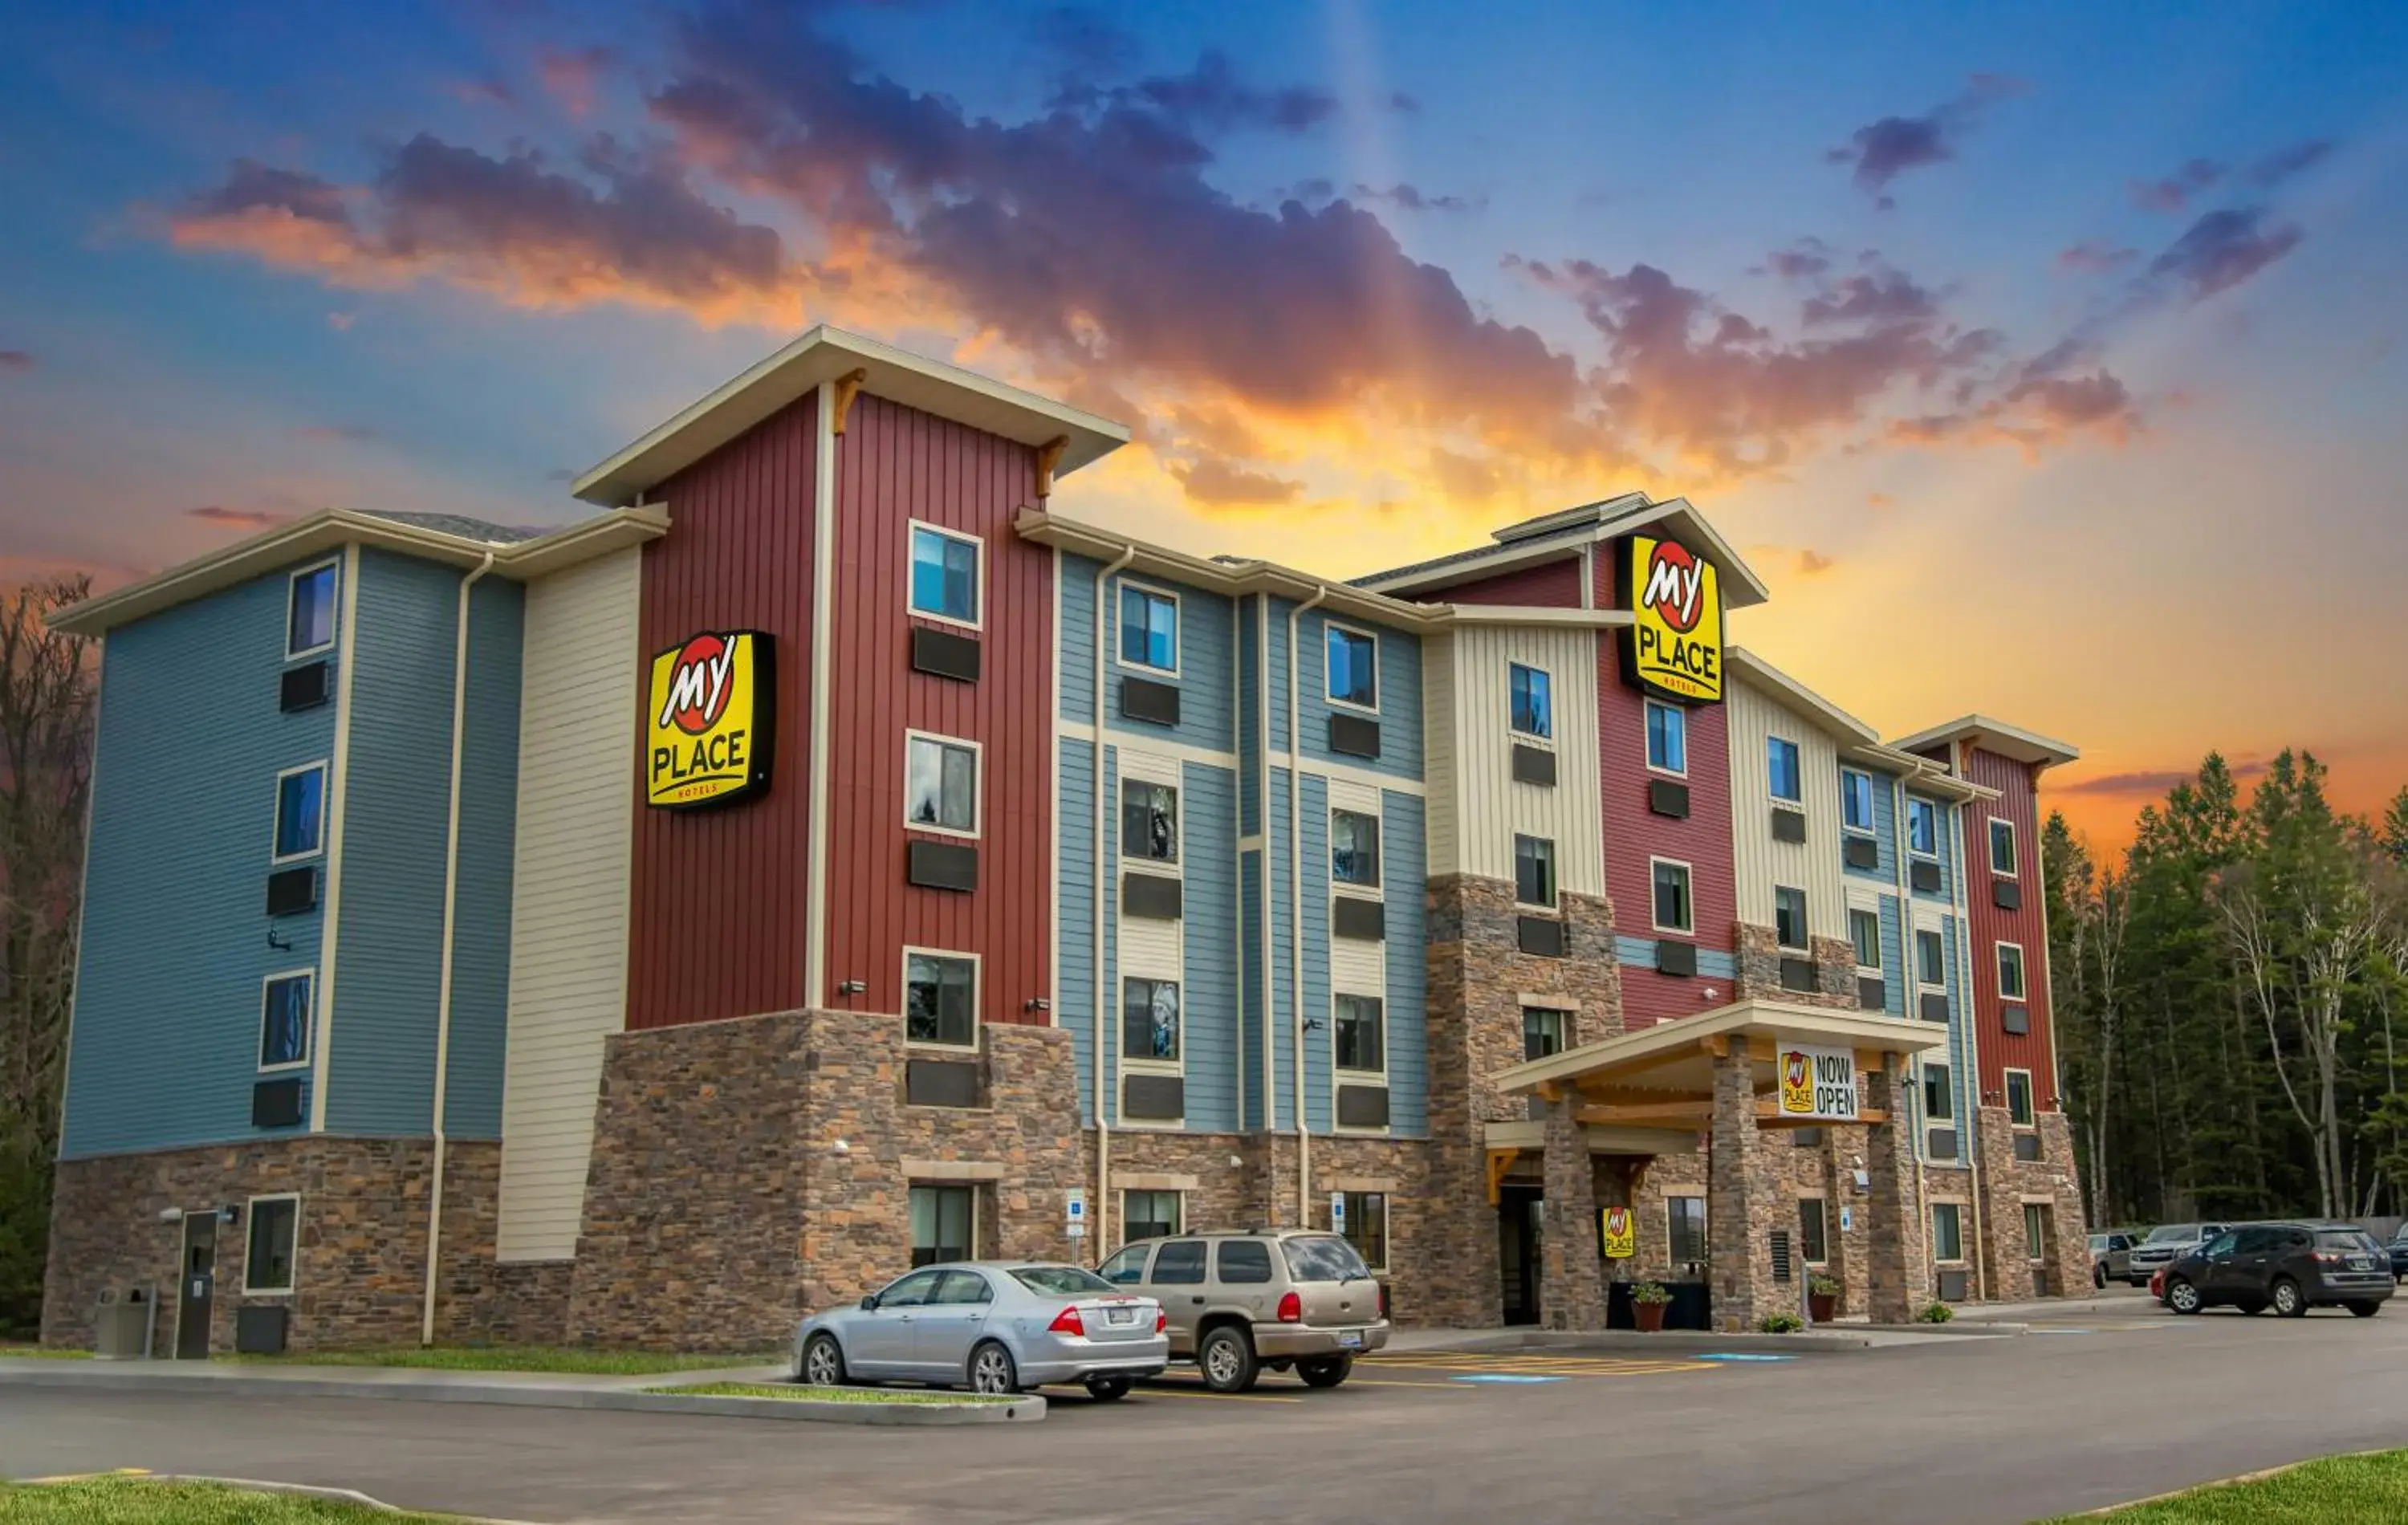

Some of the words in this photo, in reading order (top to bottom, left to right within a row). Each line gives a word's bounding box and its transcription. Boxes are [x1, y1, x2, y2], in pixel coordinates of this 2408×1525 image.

[1639, 624, 1717, 680] PLACE
[653, 730, 746, 783] PLACE
[1816, 1053, 1850, 1084] NOW
[1816, 1086, 1855, 1116] OPEN
